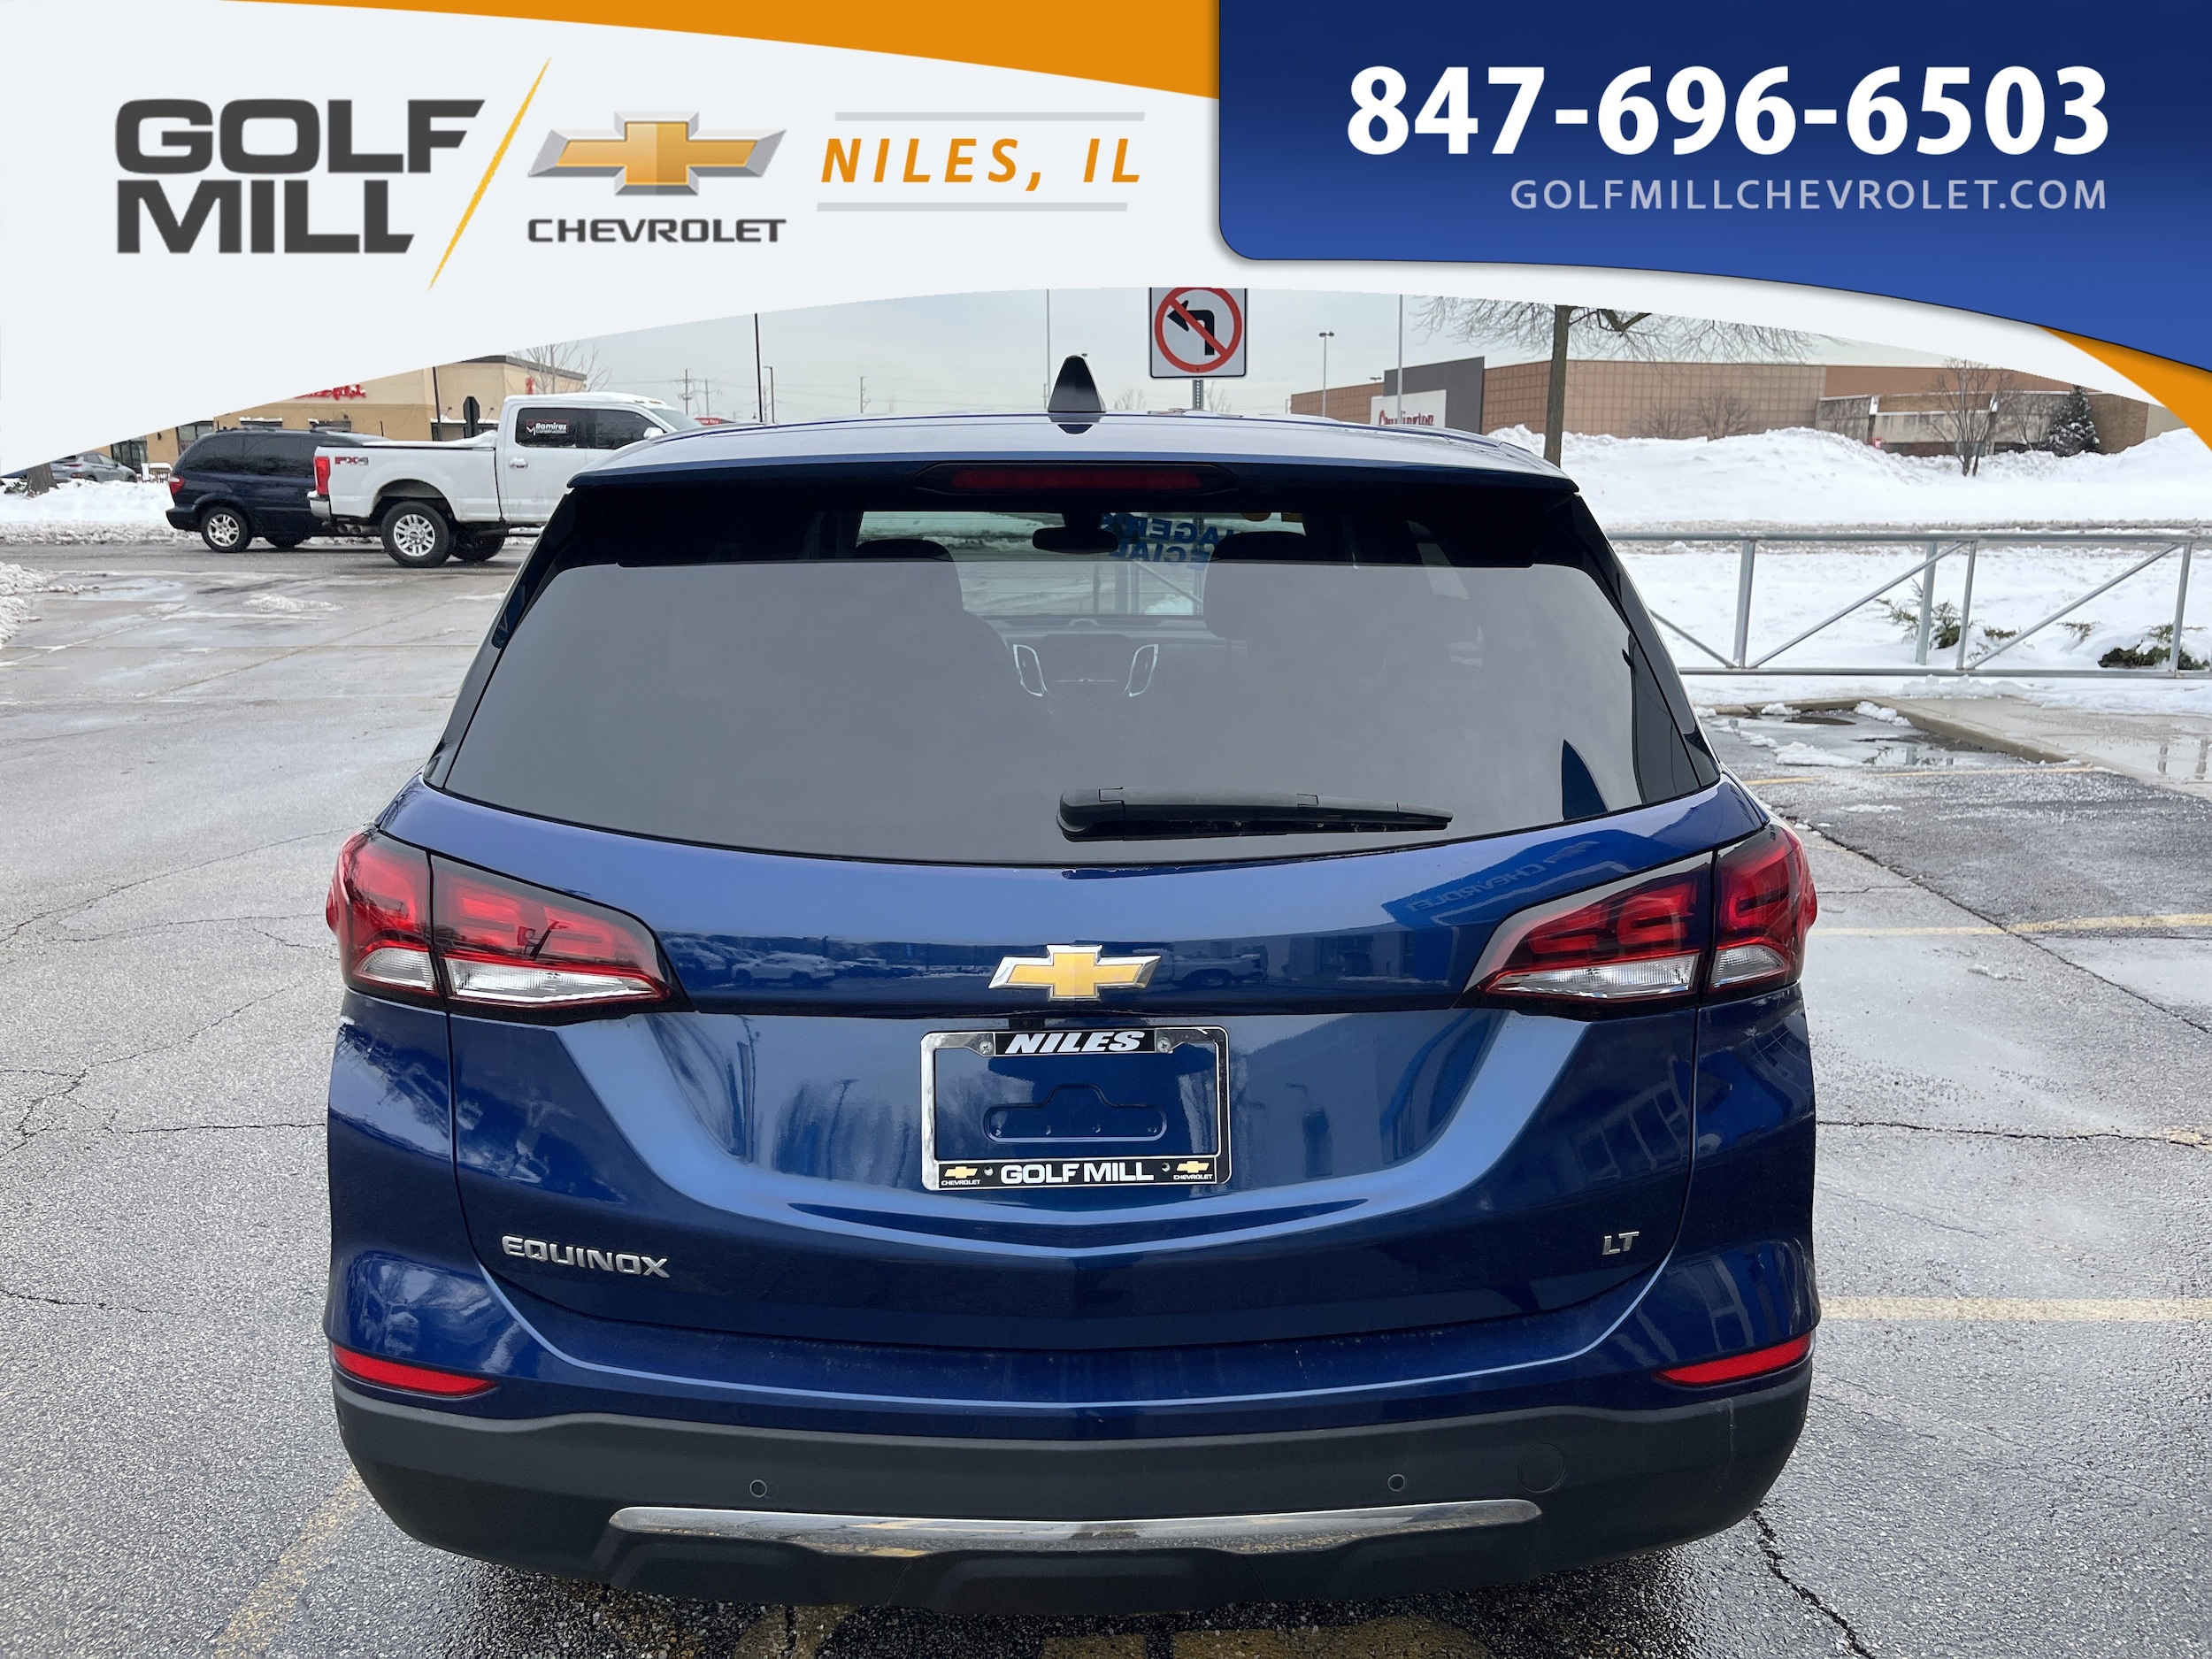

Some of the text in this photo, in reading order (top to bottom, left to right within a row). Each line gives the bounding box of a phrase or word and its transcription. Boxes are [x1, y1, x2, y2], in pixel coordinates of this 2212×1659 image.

[334, 457, 369, 465] FX4
[1004, 1031, 1146, 1055] NILES
[1000, 1161, 1155, 1185] GOLF MILL
[1602, 1231, 1640, 1256] LT
[502, 1235, 670, 1278] EQUINOX
